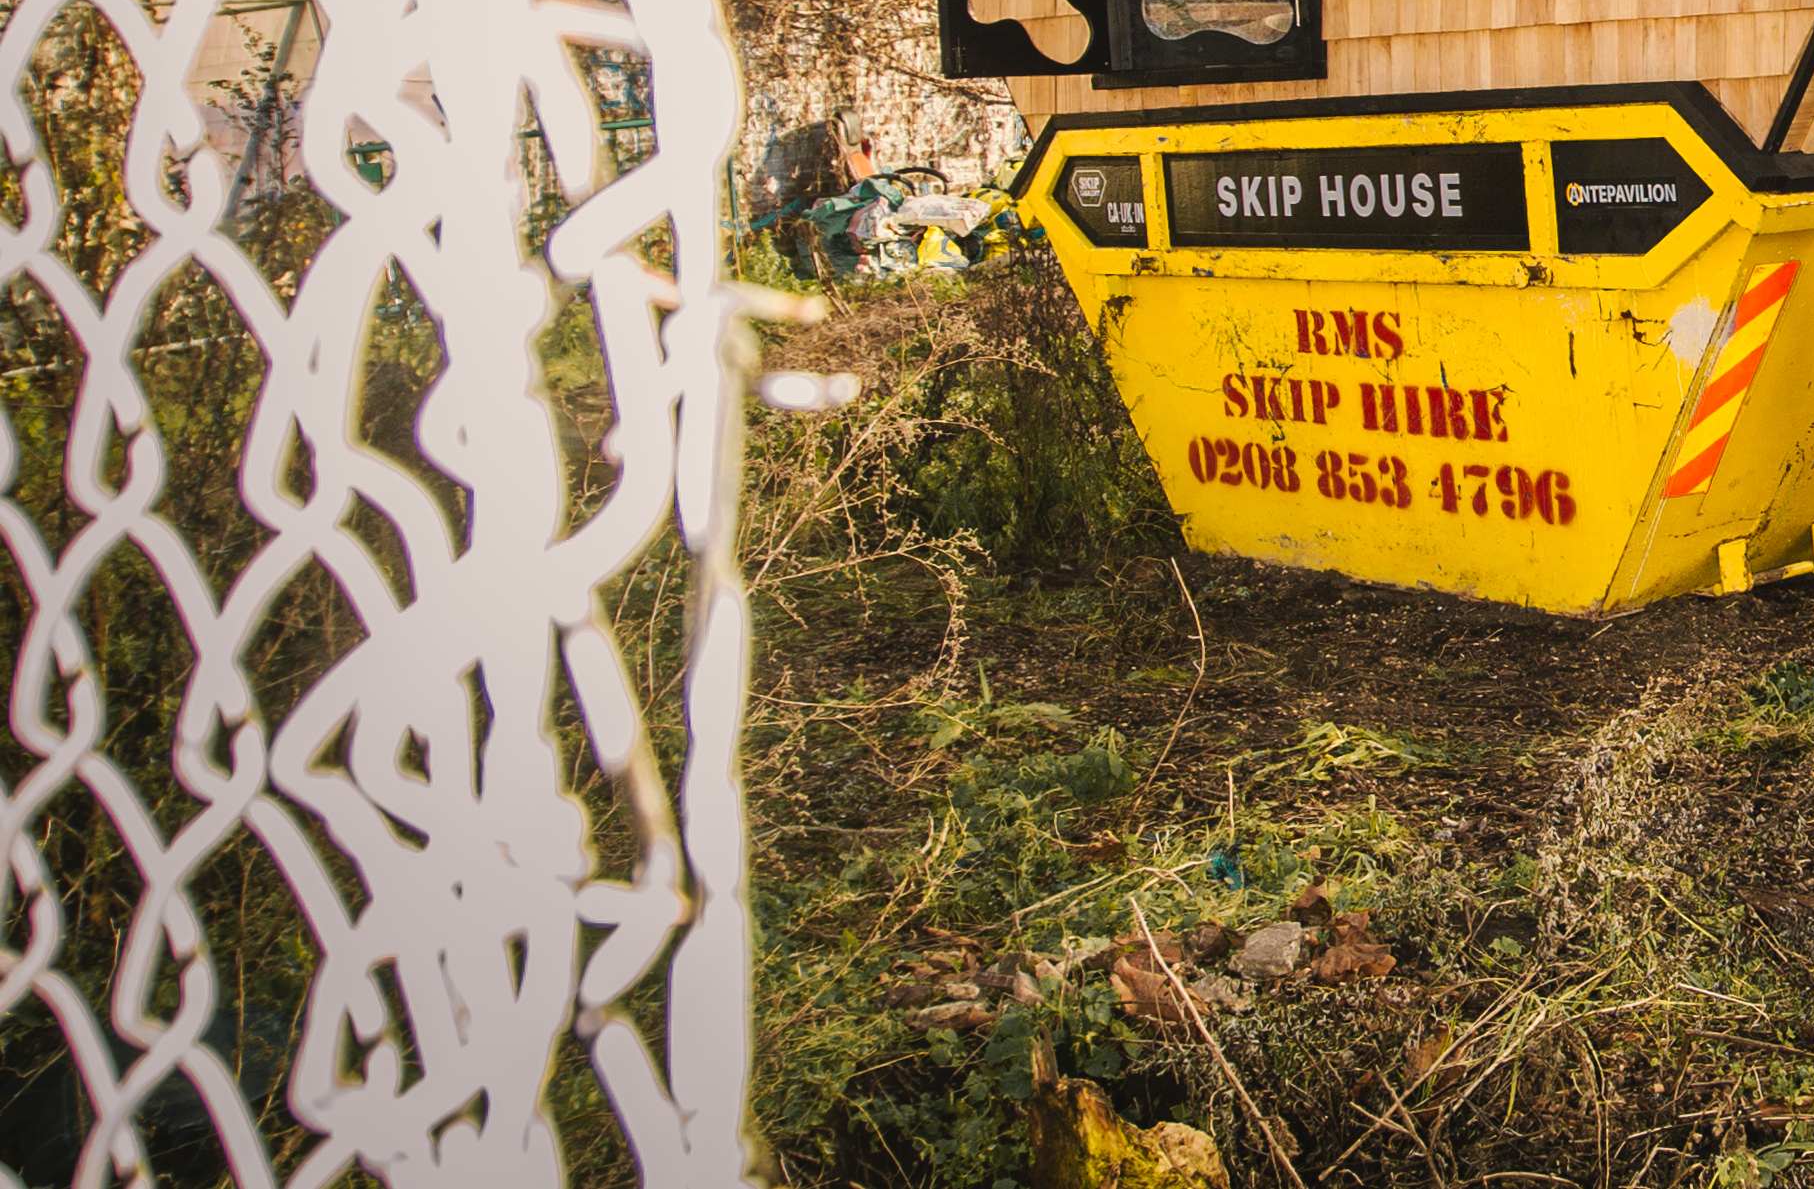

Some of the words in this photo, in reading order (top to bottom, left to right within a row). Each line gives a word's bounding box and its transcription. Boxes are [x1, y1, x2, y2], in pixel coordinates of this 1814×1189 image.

[1078, 177, 1100, 189] SKIP
[1217, 175, 1302, 217] SKIP
[1319, 172, 1463, 217] HOUSE
[1566, 182, 1677, 206] ANTEPAVILION
[1293, 309, 1404, 360] RMS
[1222, 373, 1340, 424] SKIP
[1359, 382, 1509, 443] HIRE
[1188, 436, 1301, 493] 0208
[1315, 450, 1413, 509] 853
[1429, 462, 1577, 525] 4796
